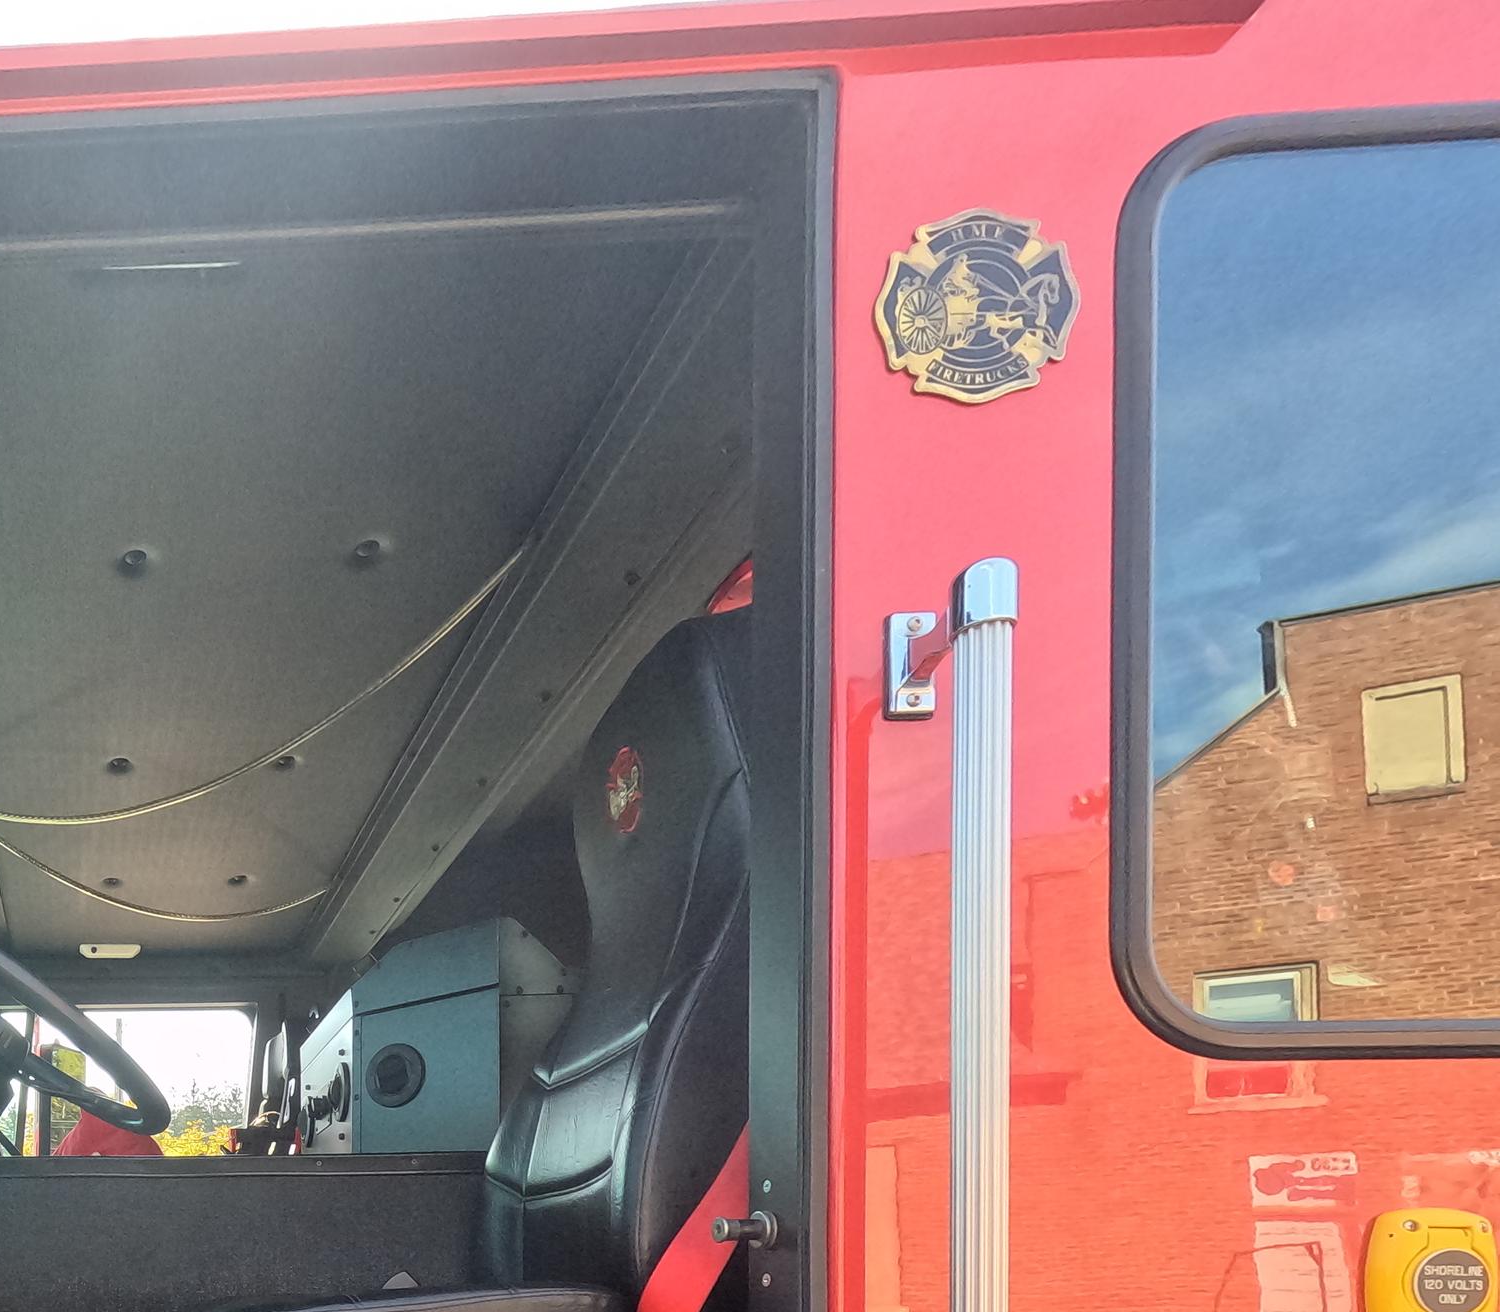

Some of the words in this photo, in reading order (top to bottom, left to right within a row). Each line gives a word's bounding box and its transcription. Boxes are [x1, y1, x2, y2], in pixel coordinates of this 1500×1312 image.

[951, 223, 1006, 242] HME
[928, 358, 1028, 386] FIRETRUCKS
[1424, 1266, 1483, 1276] SHORELINE
[1424, 1280, 1443, 1290] 120
[1447, 1280, 1483, 1290] VOLTS
[1438, 1294, 1467, 1304] ONLY
